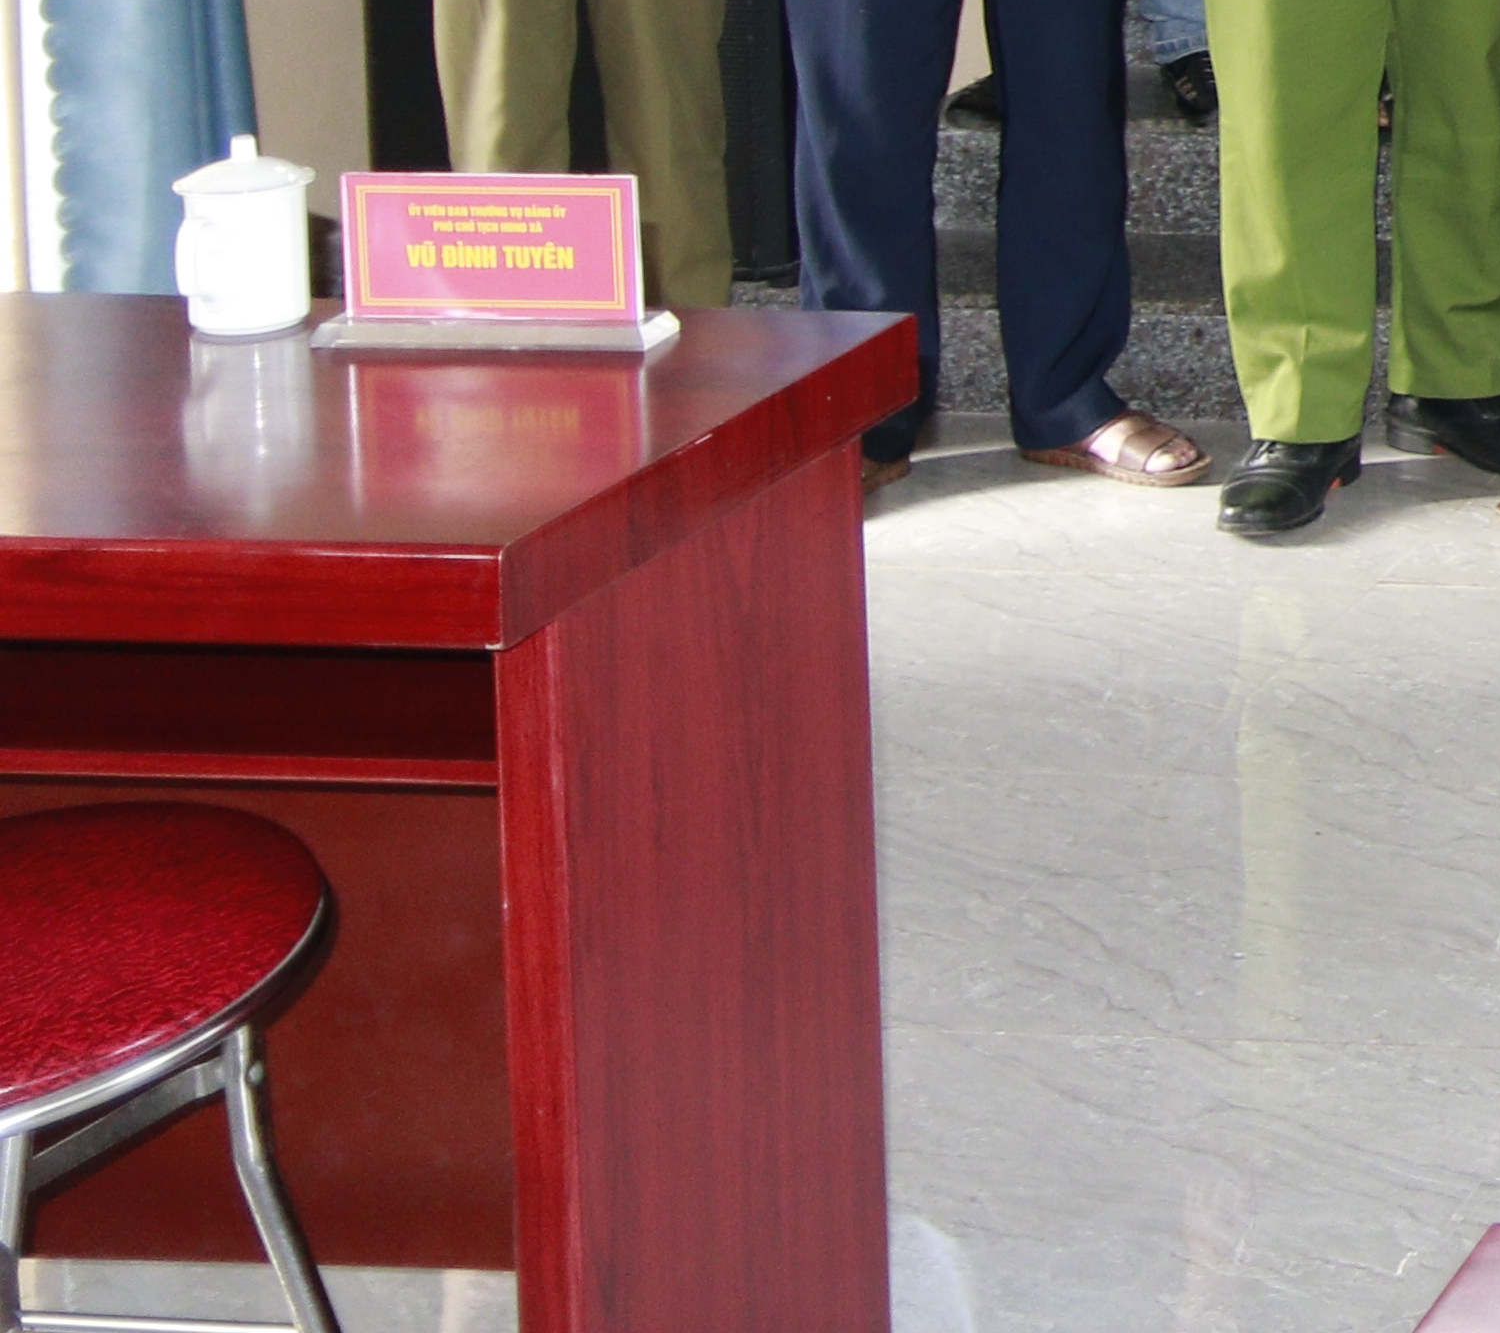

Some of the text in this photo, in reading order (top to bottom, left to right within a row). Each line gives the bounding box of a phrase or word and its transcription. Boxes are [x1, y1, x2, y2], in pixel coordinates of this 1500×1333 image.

[406, 240, 574, 270] VŨ ĐÌNH TUYÊN
